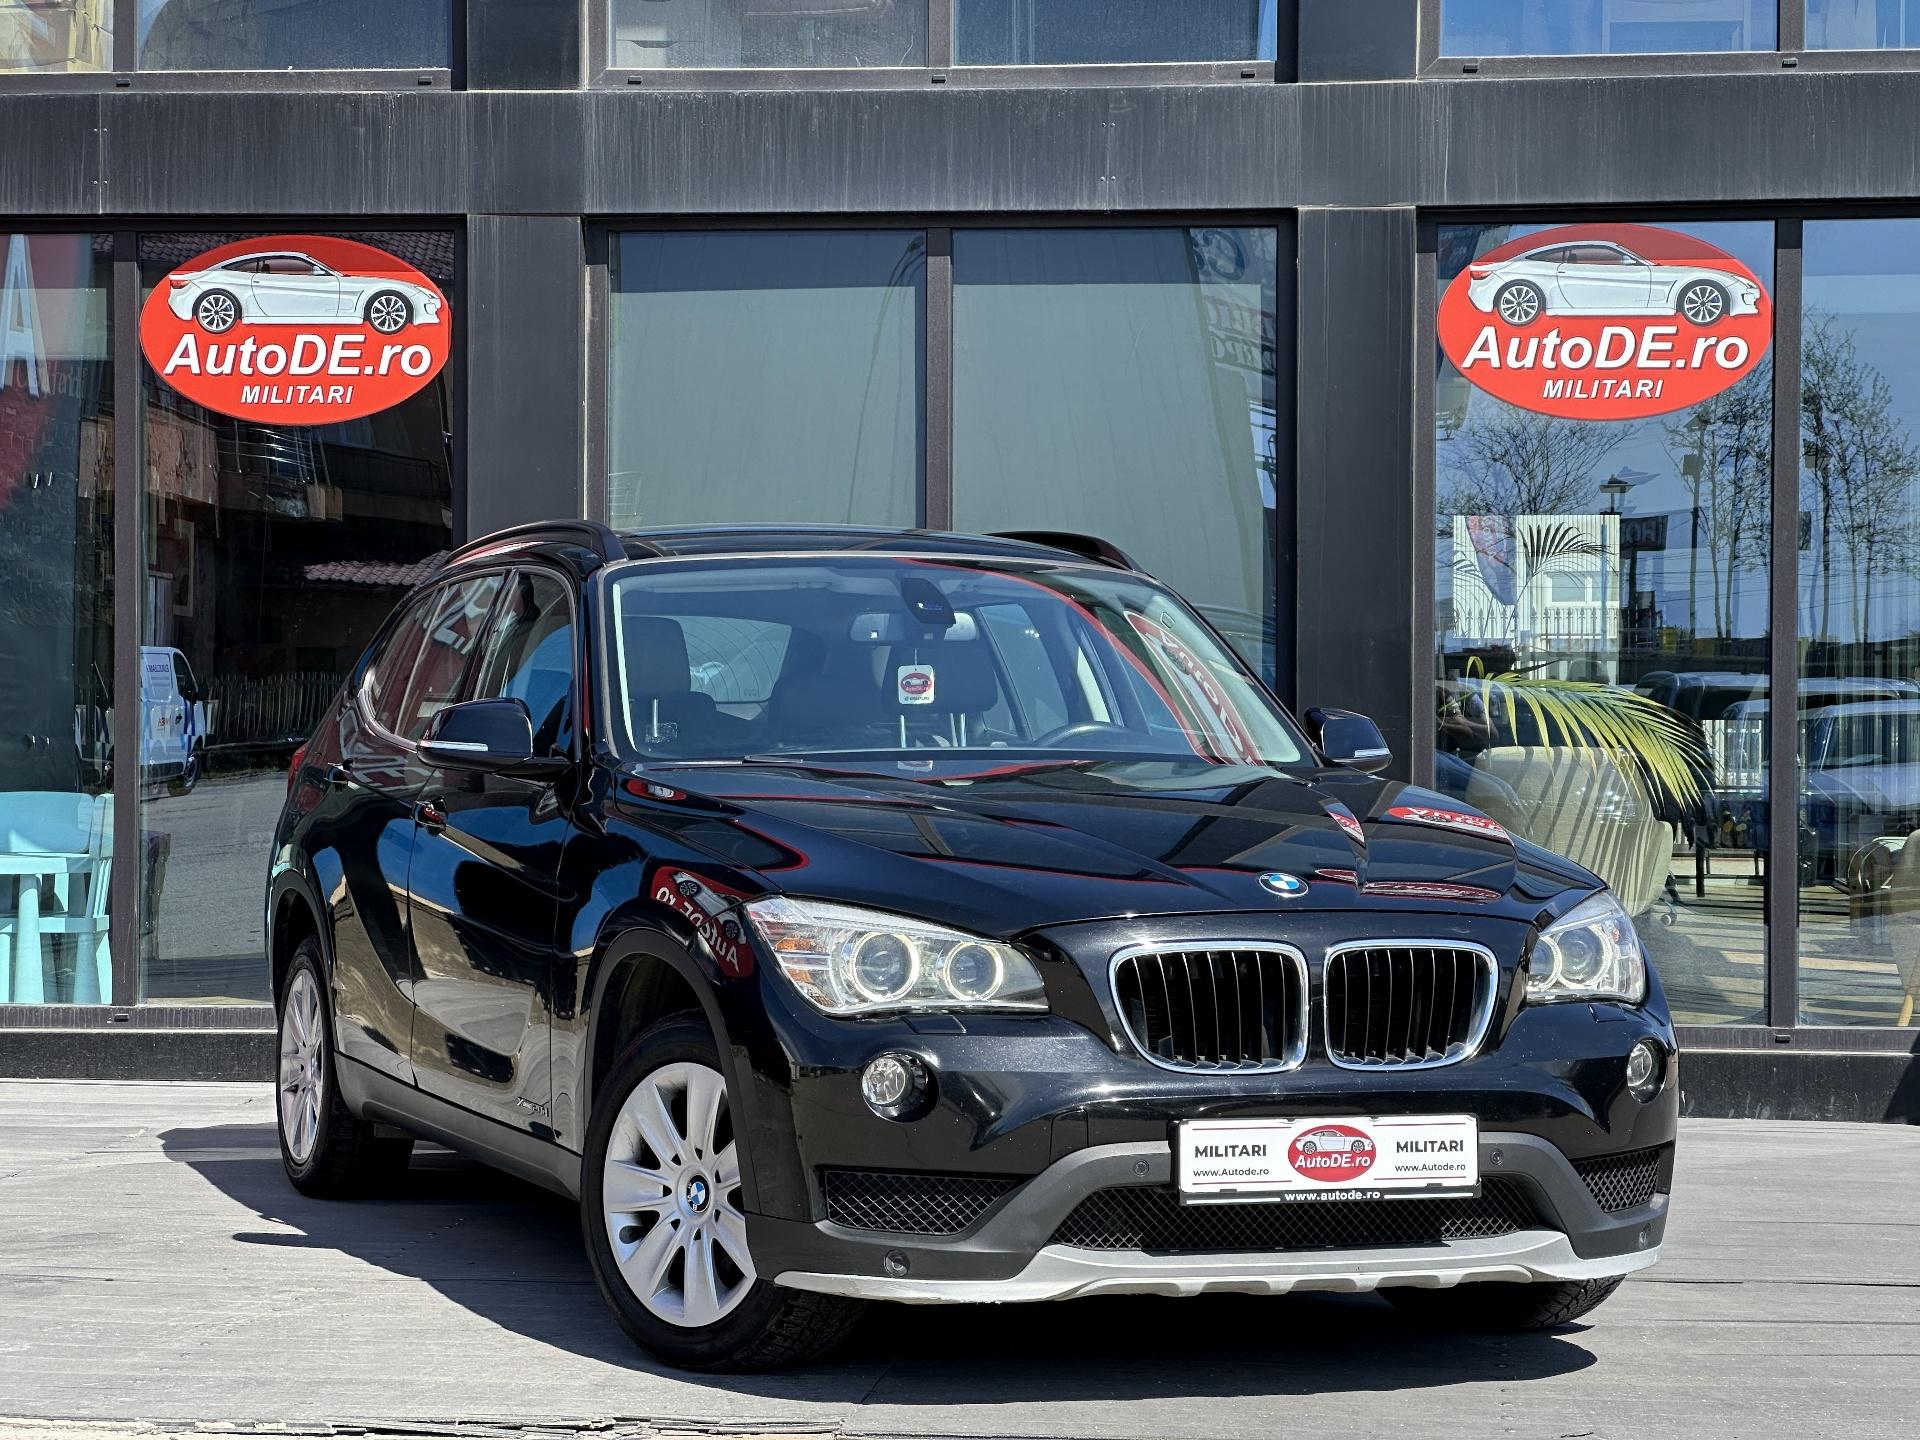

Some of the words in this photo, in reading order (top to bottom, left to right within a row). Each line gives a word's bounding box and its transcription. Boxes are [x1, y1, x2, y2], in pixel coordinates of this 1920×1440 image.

[163, 333, 432, 376] AutoDE.ro
[1461, 326, 1749, 370] AutoDE.ro
[240, 385, 354, 404] MILITARI
[1543, 379, 1664, 399] MILITARI
[1194, 1144, 1267, 1158] MILITARI
[1396, 1140, 1464, 1153] MILITARI
[1295, 1153, 1371, 1168] AutoDE.ro
[1394, 1163, 1466, 1172] www.Autode.ro
[1192, 1167, 1270, 1177] www.Autode.ro
[1284, 1190, 1381, 1201] www.autode.ro
